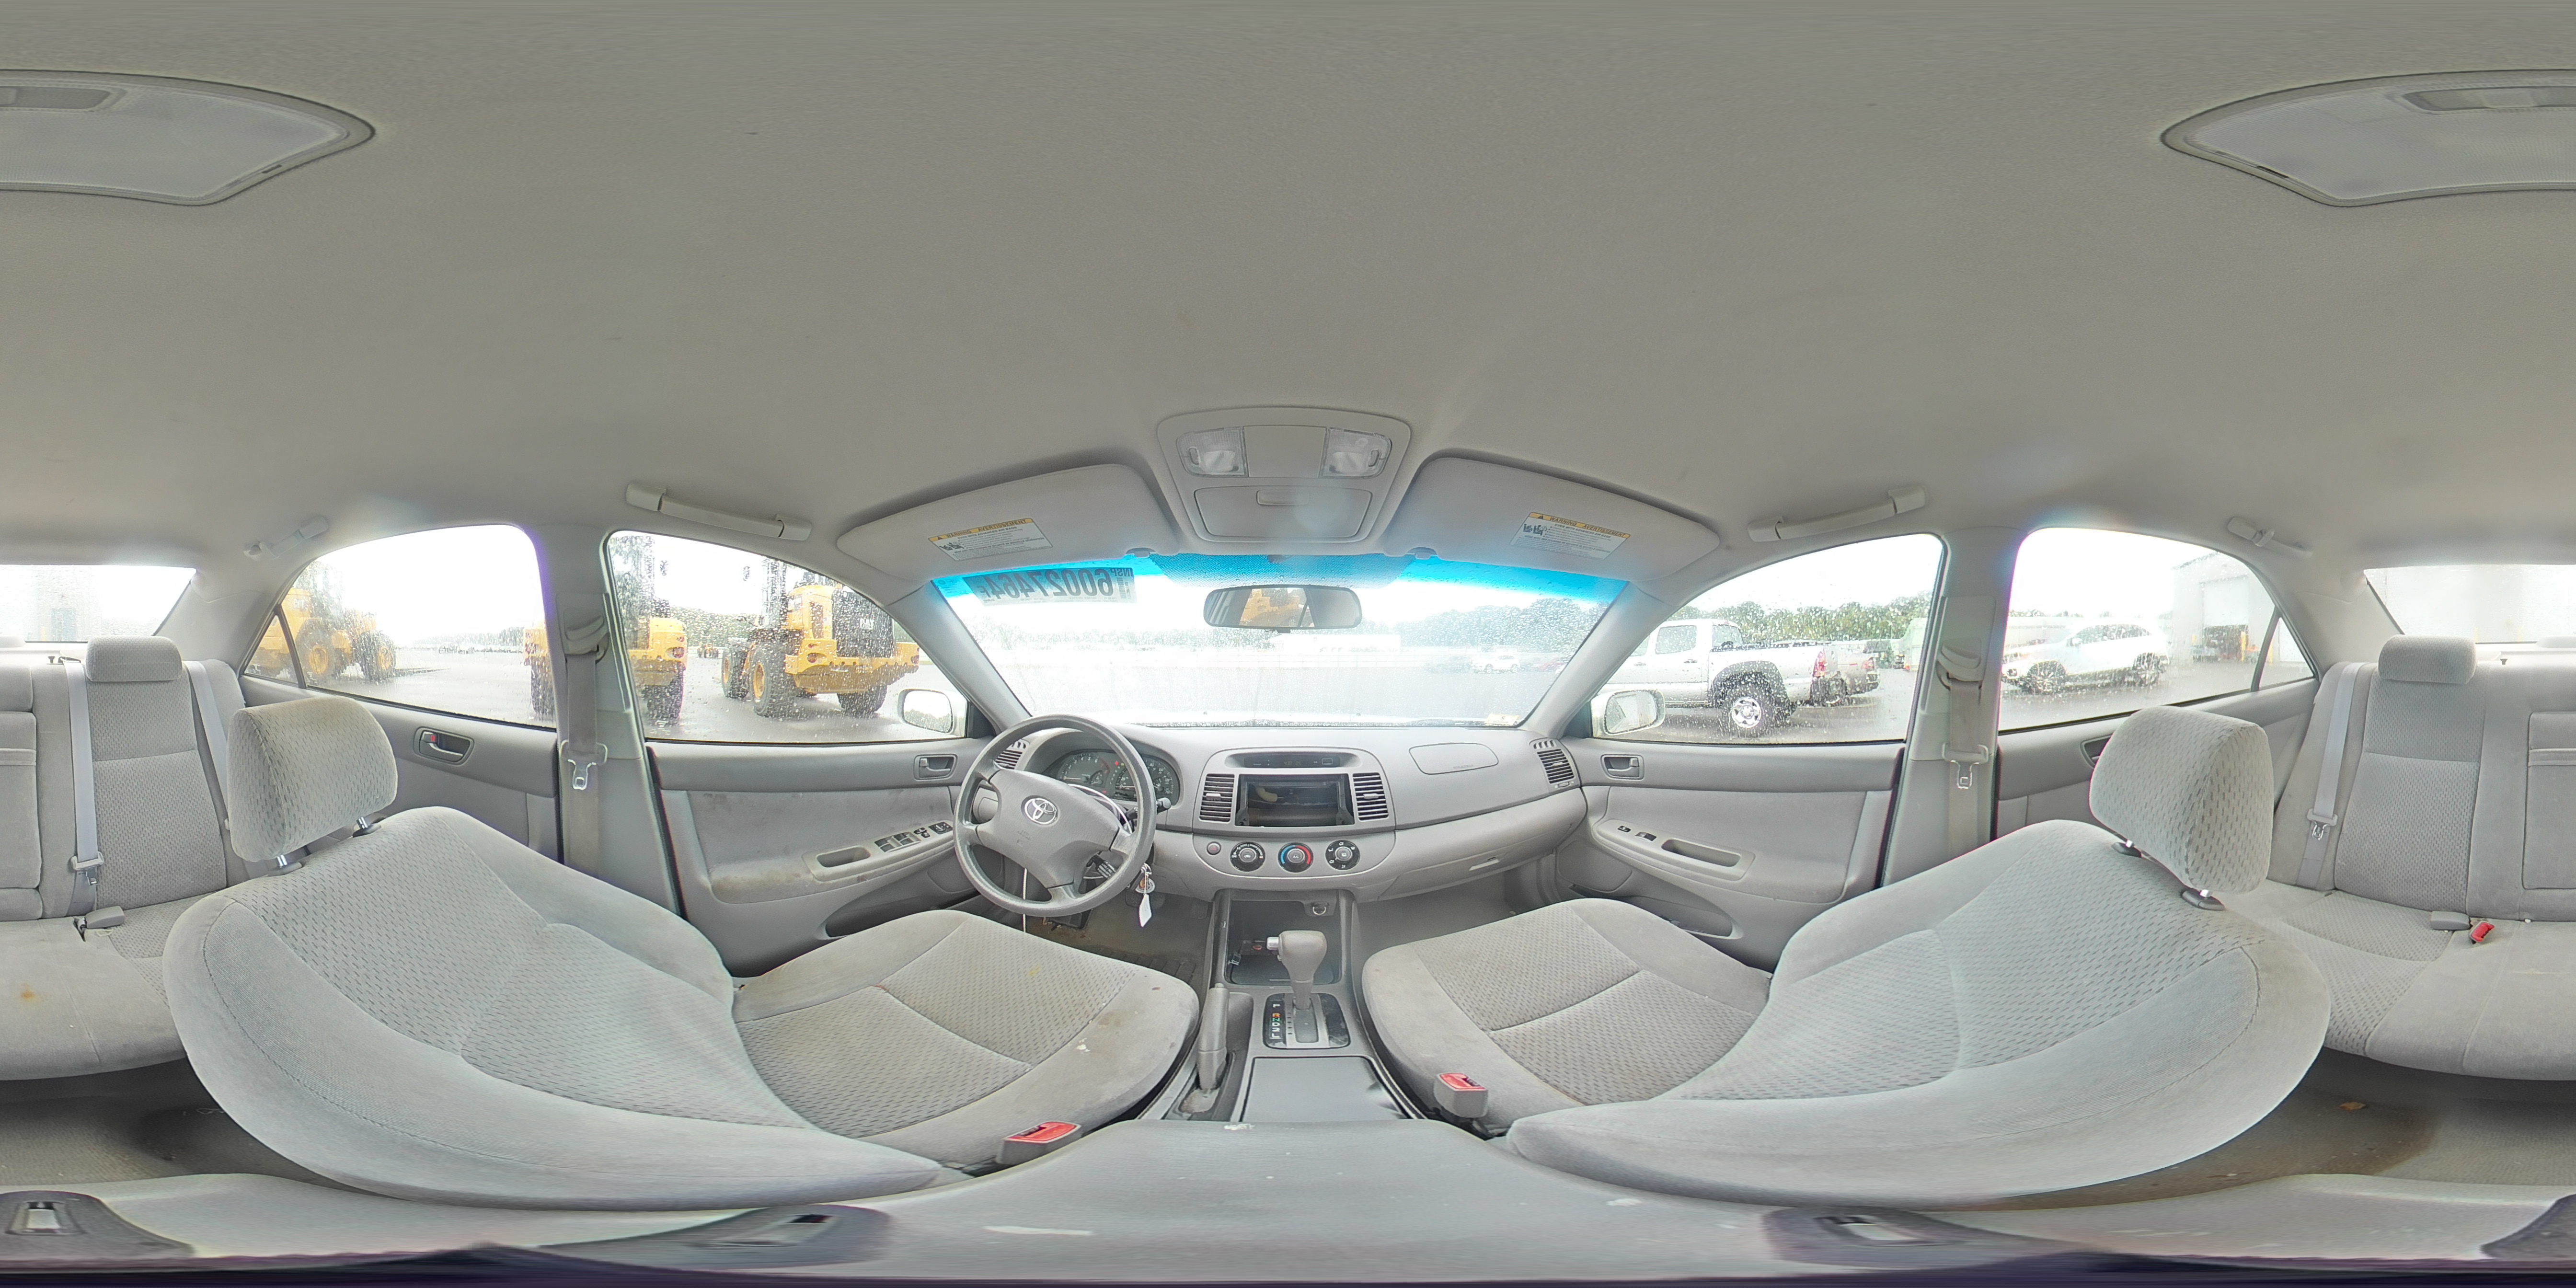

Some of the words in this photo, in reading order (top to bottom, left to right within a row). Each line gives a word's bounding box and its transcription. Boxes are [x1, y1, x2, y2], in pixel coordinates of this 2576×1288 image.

[978, 519, 1026, 532] AVERTISSEMENT
[1550, 517, 1577, 526] WARNING
[1583, 524, 1626, 537] AVERTISSEMENT
